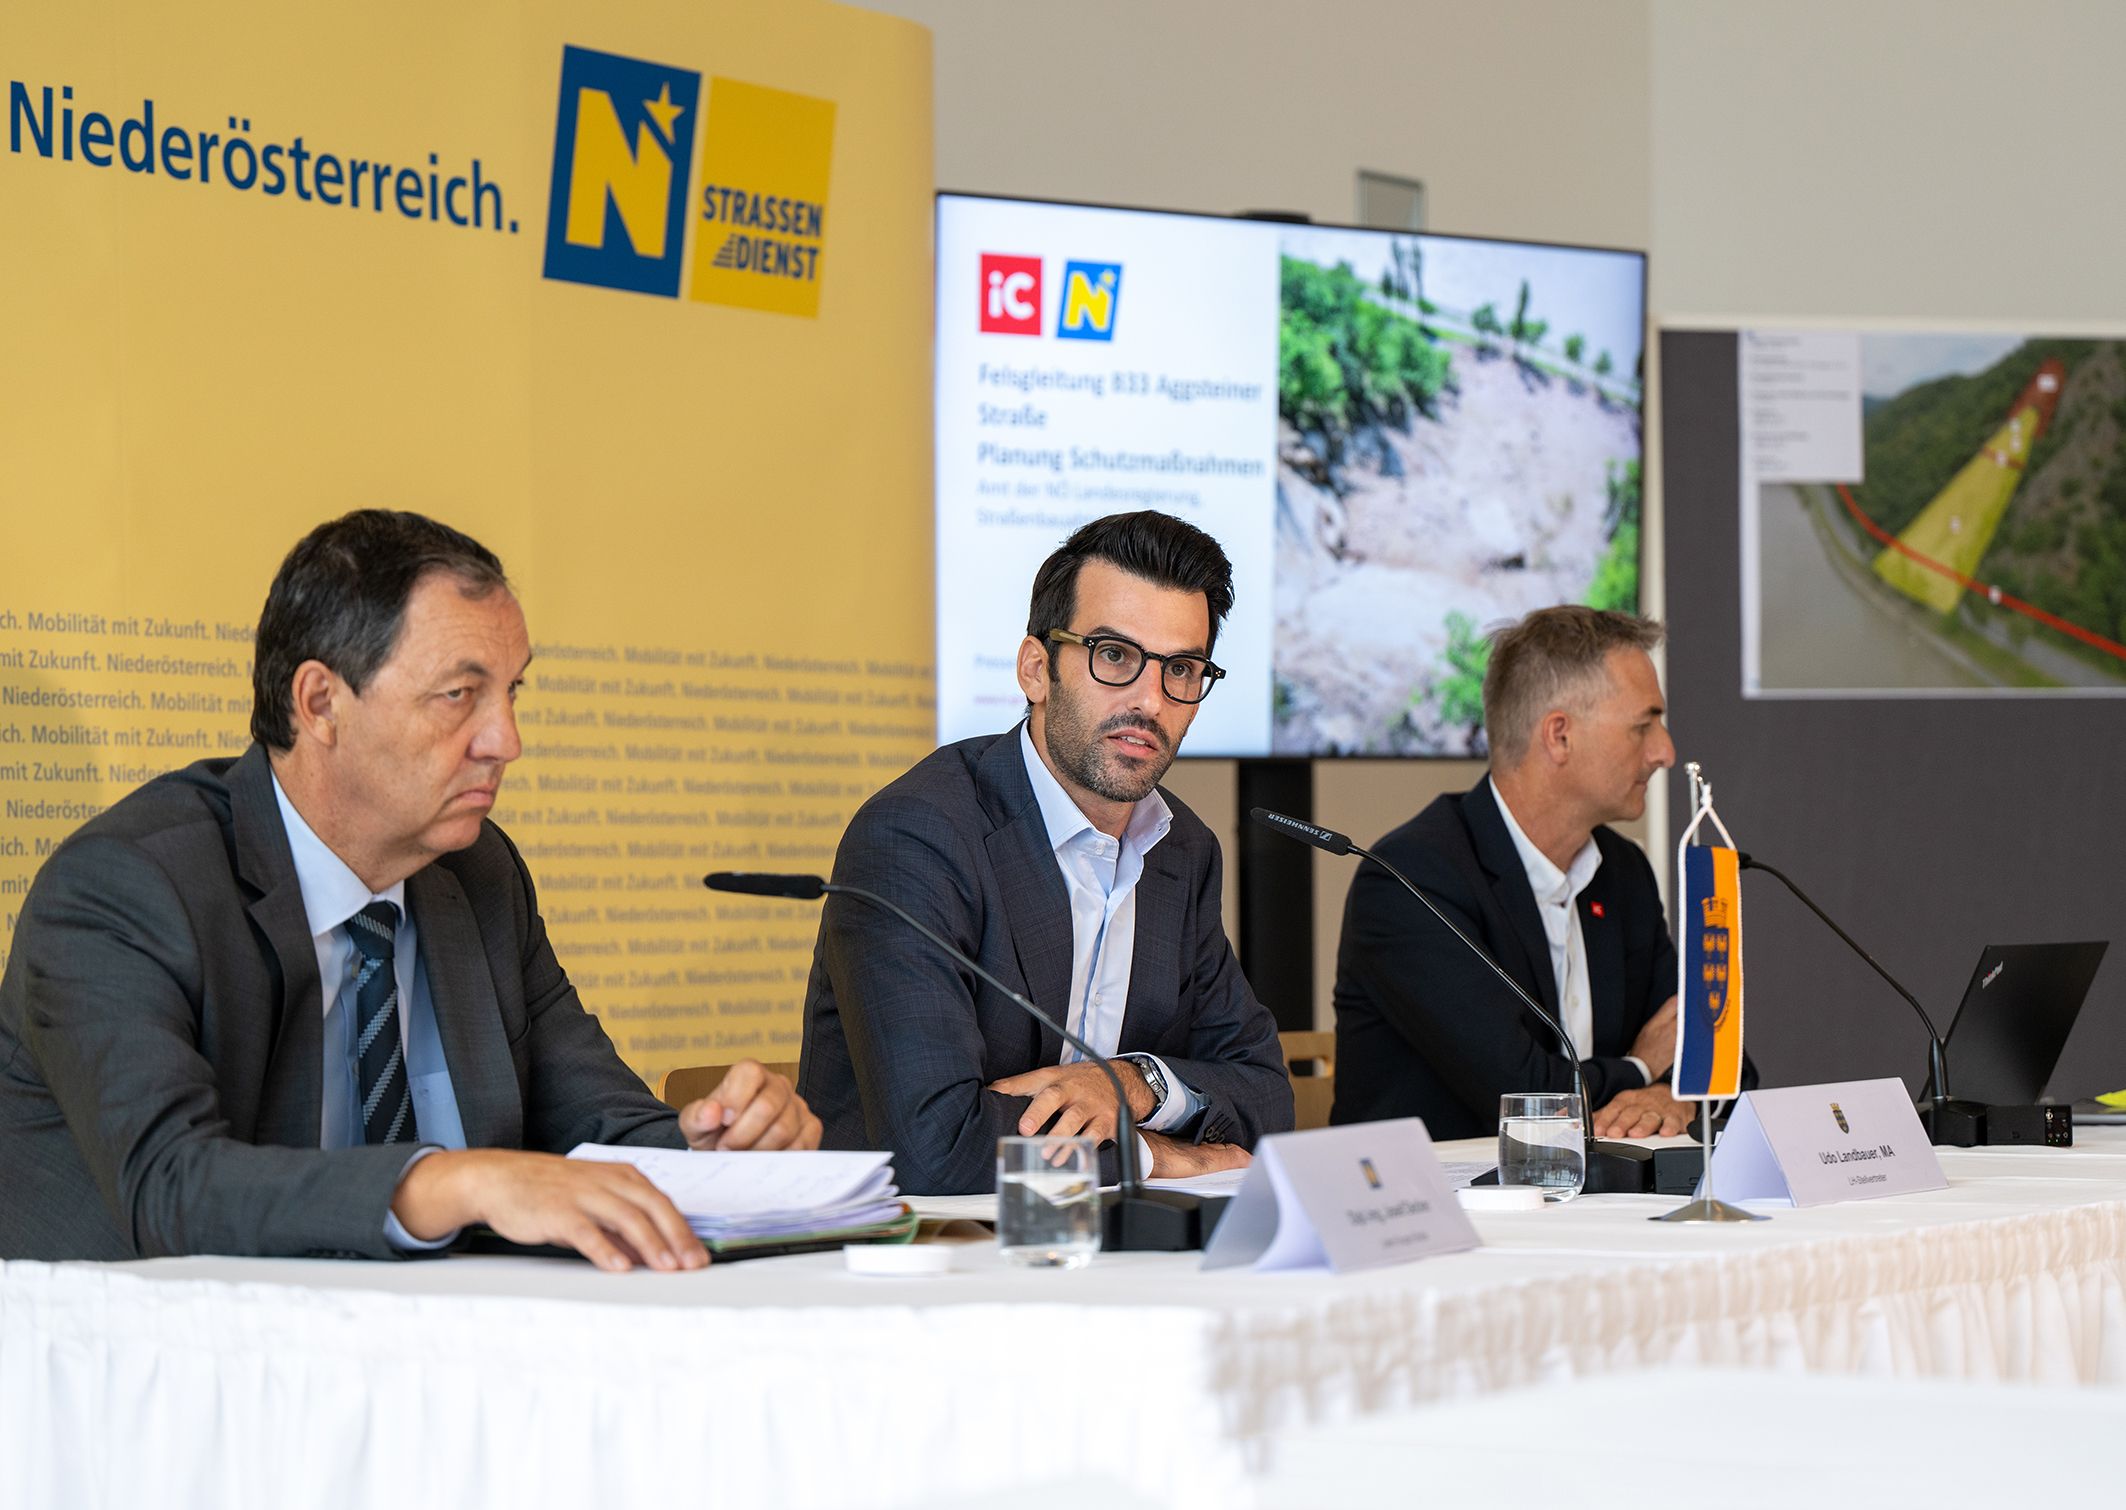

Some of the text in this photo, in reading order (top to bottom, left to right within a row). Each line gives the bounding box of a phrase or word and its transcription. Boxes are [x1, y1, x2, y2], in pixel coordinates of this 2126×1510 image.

[9, 79, 520, 235] Niederösterreich.
[702, 184, 823, 238] STRASSEN
[736, 235, 819, 281] DIENST
[988, 270, 1036, 320] iC
[978, 363, 1105, 396] Felsgleitung
[978, 403, 1047, 428] Straße
[978, 442, 1265, 477] Planung Schutzmaßnahmen
[28, 611, 107, 635] Mobilität
[112, 616, 140, 637] mit
[144, 618, 211, 641] Zukunft.
[29, 649, 101, 672] Zukunft.
[107, 653, 242, 679] Niederösterreich.
[2, 686, 252, 714] Niederösterreich. Mobilität mit
[31, 724, 108, 746] Mobilität
[114, 727, 141, 747] mit
[147, 729, 213, 749] Zukunft.
[1, 762, 28, 782] mit
[33, 762, 104, 784] Zukunft.
[1268, 813, 1320, 836] SENNHEISER
[1818, 1144, 1896, 1165] Udo Landbauer, MA
